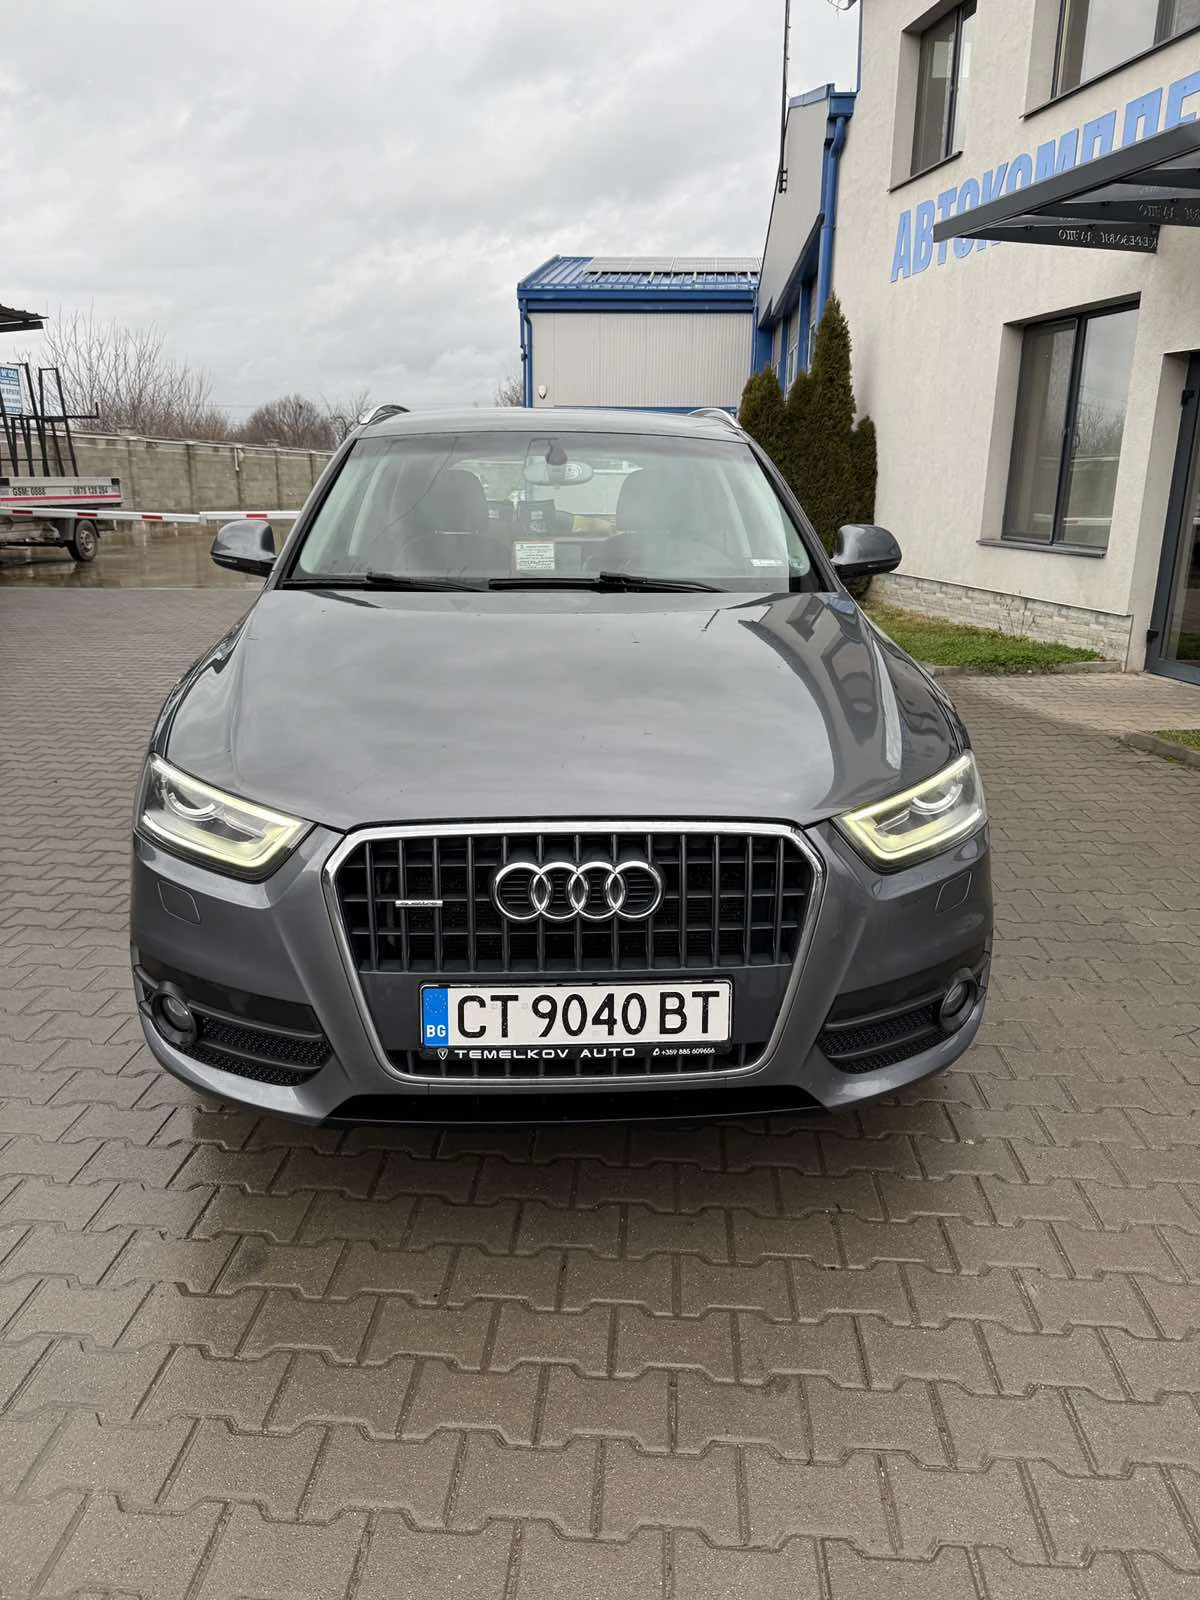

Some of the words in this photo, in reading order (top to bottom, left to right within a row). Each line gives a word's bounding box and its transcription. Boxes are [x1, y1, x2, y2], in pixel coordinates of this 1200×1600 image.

[457, 994, 519, 1038] CT
[532, 992, 647, 1037] 9040
[659, 990, 720, 1035] BT
[426, 1024, 447, 1037] BG
[454, 1049, 569, 1059] TEMELKOV
[580, 1047, 636, 1058] AUTO
